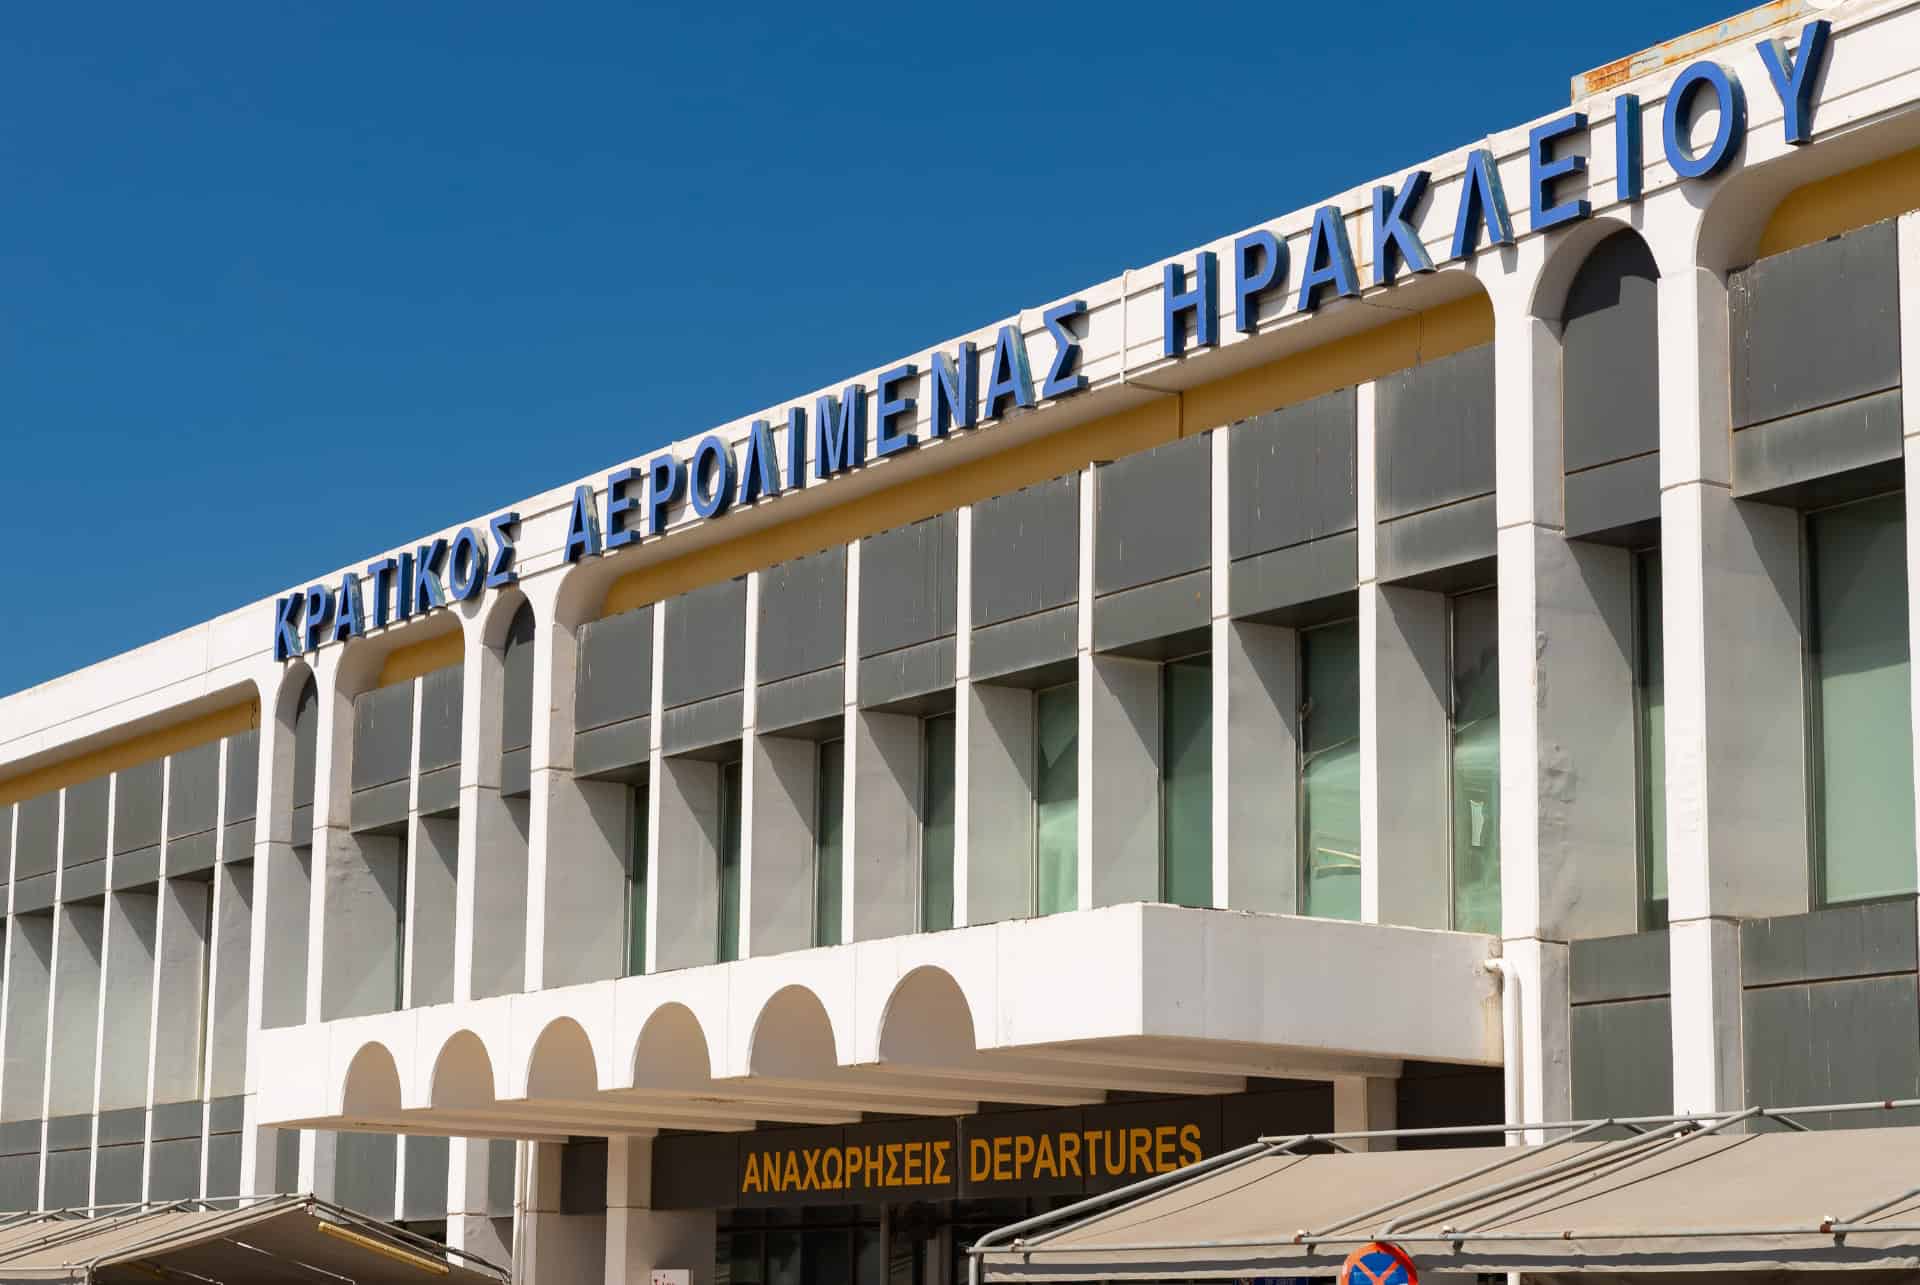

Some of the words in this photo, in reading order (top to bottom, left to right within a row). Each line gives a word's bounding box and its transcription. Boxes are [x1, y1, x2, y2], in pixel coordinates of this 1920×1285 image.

[274, 512, 520, 661] ΚΡΑΤΙΚΟΣ
[565, 300, 1088, 562] ΑΕΡΟΛΙΜΕΝΑΣ
[1164, 20, 1831, 358] ΗΡΑΚΛΕΙΟΥ
[742, 1141, 951, 1193] ΑΝΑΧΩΡΗΣΕΙΣ
[970, 1124, 1202, 1182] DEPARTURES
